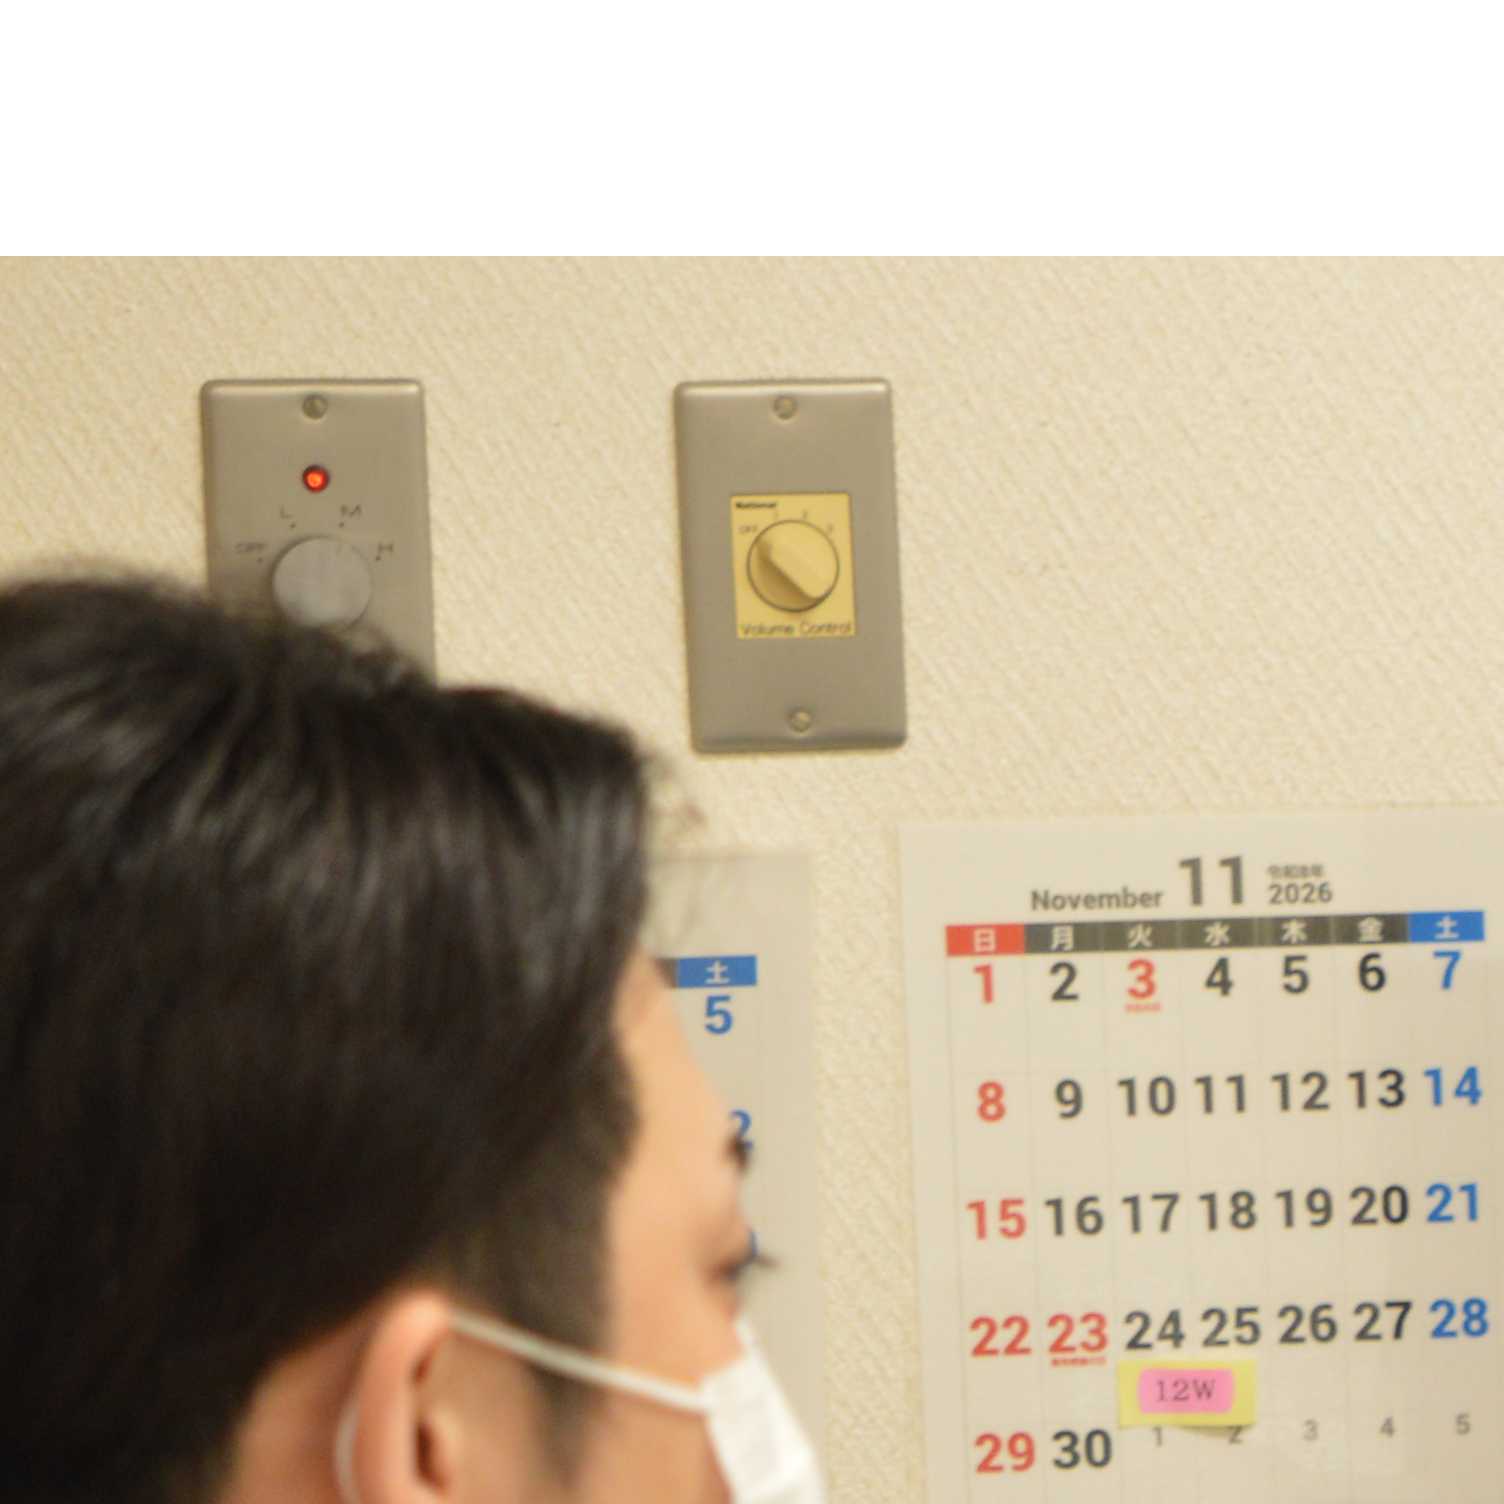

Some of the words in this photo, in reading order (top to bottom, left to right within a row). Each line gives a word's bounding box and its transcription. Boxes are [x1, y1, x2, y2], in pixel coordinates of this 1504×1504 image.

[1032, 887, 1162, 910] November
[1179, 856, 1243, 906] 11
[1266, 878, 1336, 906] 2026
[973, 929, 997, 952] 日
[1050, 926, 1075, 950] 月
[1127, 924, 1152, 948] 火
[1205, 922, 1230, 946] 水
[1281, 919, 1307, 944] 木
[1357, 917, 1384, 942] 金
[1434, 916, 1460, 940] 土
[704, 960, 733, 984] 土
[974, 964, 993, 1003] 1
[1050, 962, 1078, 1002] 2
[1127, 958, 1157, 1001] 3
[1205, 957, 1233, 996] 4
[1284, 955, 1309, 994] 5
[1359, 953, 1386, 992] 6
[1434, 950, 1461, 990] 7
[704, 996, 732, 1036] 5
[977, 1081, 1006, 1123] 8
[1055, 1079, 1082, 1119] 9
[1118, 1076, 1175, 1116] 10
[1195, 1074, 1245, 1114] 11
[1272, 1071, 1329, 1111] 12
[1349, 1068, 1405, 1108] 13
[1424, 1066, 1482, 1105] 14
[968, 1198, 1026, 1239] 15
[1045, 1196, 1104, 1236] 16
[1122, 1192, 1179, 1234] 17
[1200, 1190, 1256, 1230] 18
[1276, 1187, 1332, 1228] 19
[1352, 1185, 1408, 1224] 20
[1427, 1184, 1477, 1222] 21
[970, 1315, 1032, 1357] 22
[1047, 1313, 1108, 1354] 23
[1126, 1310, 1184, 1350] 24
[1200, 1307, 1260, 1350] 25
[1277, 1304, 1338, 1345] 26
[1355, 1301, 1412, 1340] 27
[1431, 1298, 1489, 1339] 28
[1155, 1378, 1216, 1402] 12W
[974, 1431, 1036, 1473] 29
[1053, 1429, 1111, 1472] 30
[1303, 1418, 1318, 1442] 3
[1381, 1415, 1395, 1437] 4
[1456, 1413, 1471, 1436] 5
